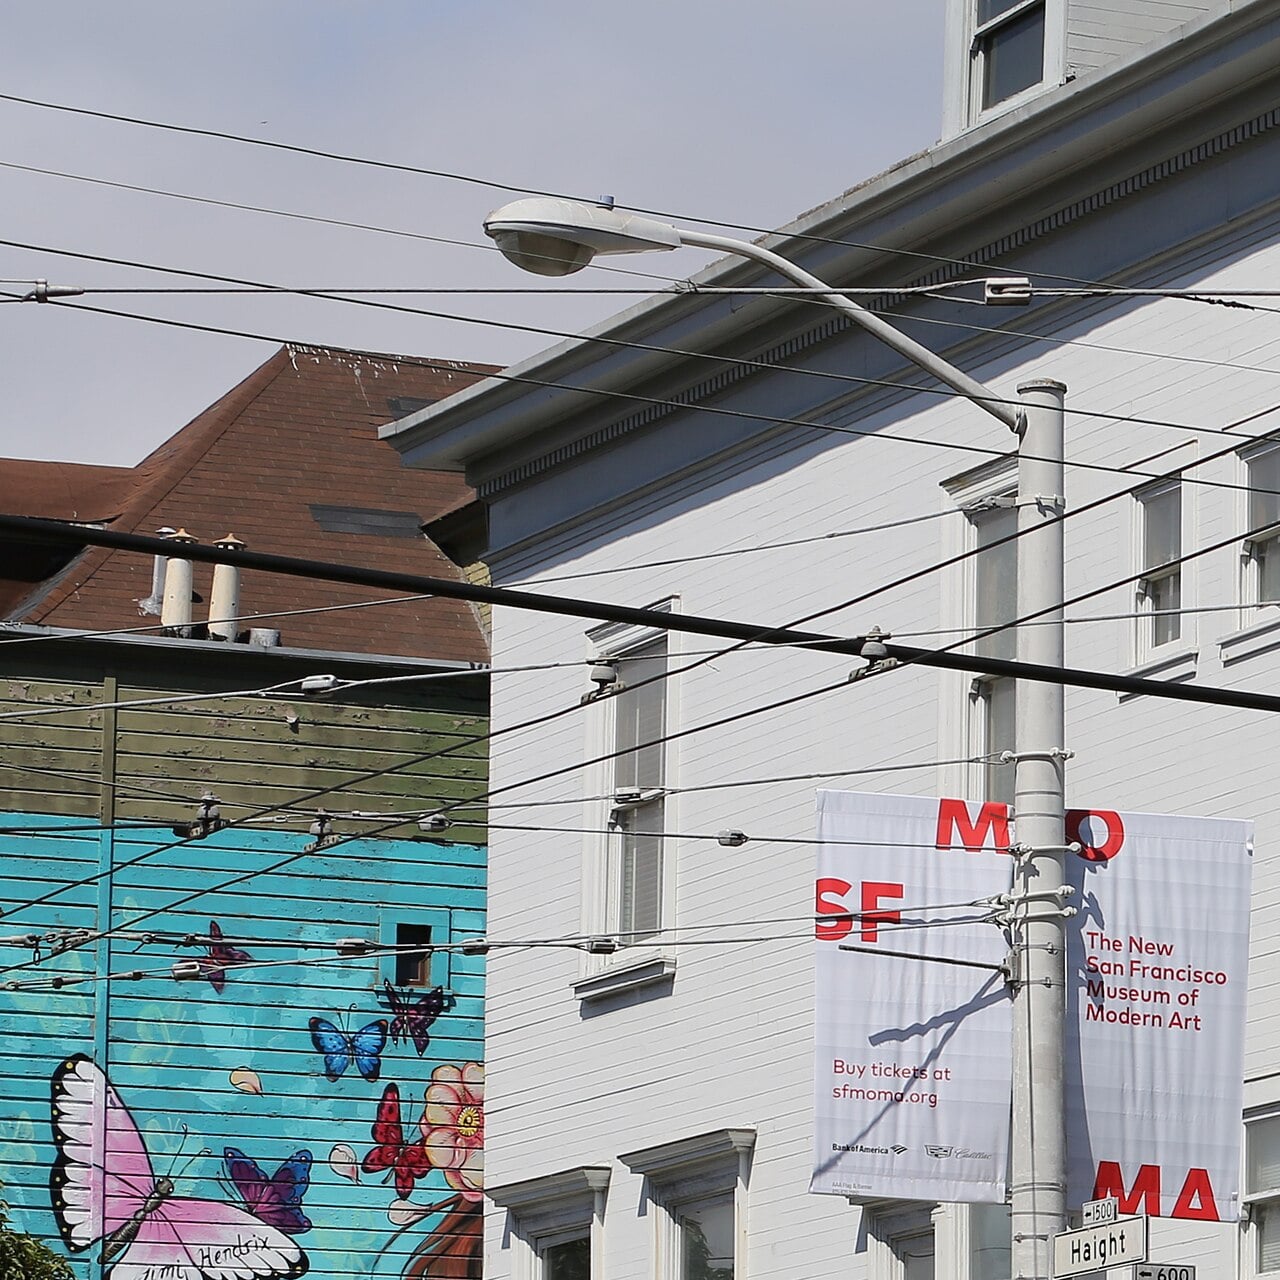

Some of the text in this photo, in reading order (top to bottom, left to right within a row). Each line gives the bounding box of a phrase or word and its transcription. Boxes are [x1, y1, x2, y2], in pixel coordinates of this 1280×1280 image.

[815, 877, 905, 943] SF
[1086, 931, 1174, 957] The New
[1086, 956, 1228, 985] San Francisco
[1086, 979, 1200, 1007] Museum of
[1085, 1003, 1202, 1031] Modern Art
[833, 1059, 952, 1081] Buy tickets at
[832, 1084, 938, 1108] sfmoma.org
[832, 1143, 889, 1155] Bank of America
[1091, 1160, 1221, 1222] MA
[1092, 1201, 1112, 1221] 1500
[199, 1233, 271, 1268] Hendrix
[1071, 1230, 1126, 1265] Haight
